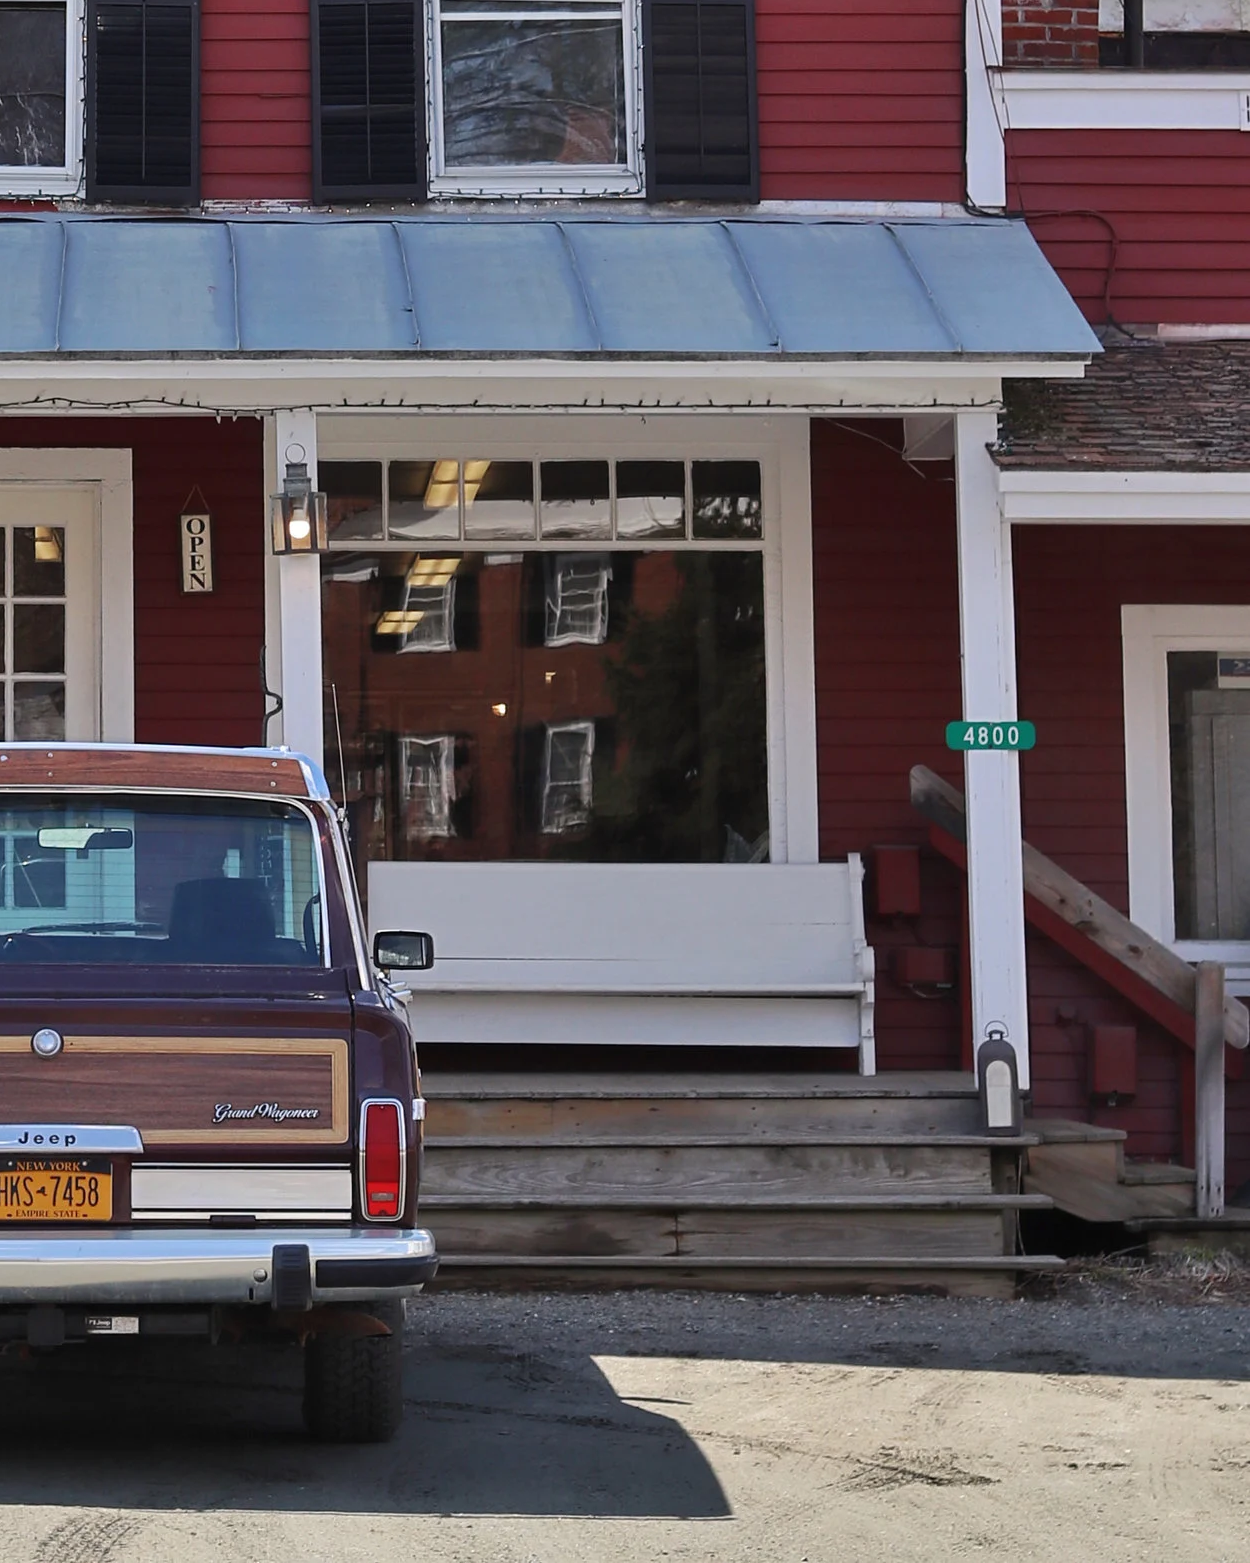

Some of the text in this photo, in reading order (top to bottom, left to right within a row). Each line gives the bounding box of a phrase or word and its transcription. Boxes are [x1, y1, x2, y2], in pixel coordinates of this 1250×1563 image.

[186, 517, 206, 590] OPEN
[963, 726, 1019, 746] 4800
[212, 1103, 319, 1123] Grand Wagoneer
[18, 1131, 76, 1147] Jeep
[16, 1161, 81, 1172] NEW YORK
[15, 1209, 81, 1218] EMPIRE STATE
